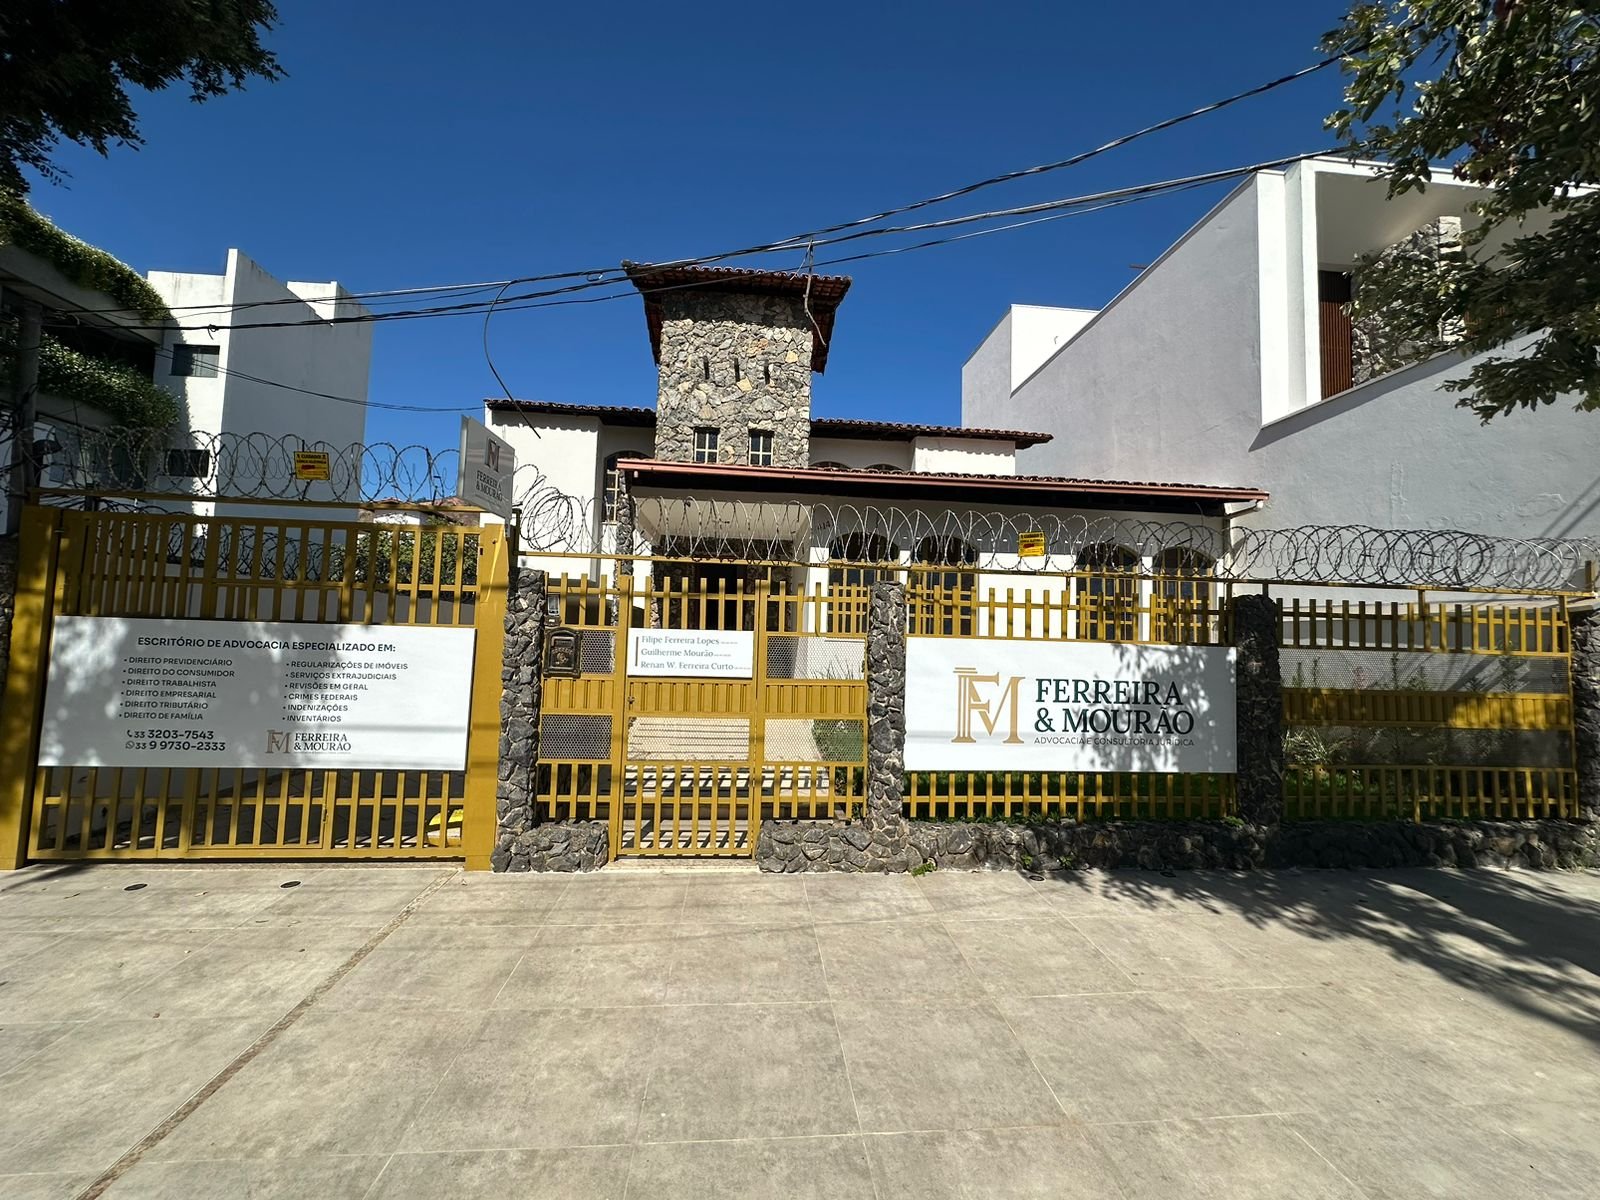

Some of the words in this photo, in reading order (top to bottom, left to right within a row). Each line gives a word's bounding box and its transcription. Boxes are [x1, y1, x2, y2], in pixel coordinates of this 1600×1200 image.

[138, 636, 205, 648] ESCRITÓRIO
[207, 640, 221, 648] DE
[223, 640, 290, 650] ADVOCACIA
[292, 642, 376, 652] ESPECIALIZADO
[378, 644, 396, 652] EM:
[641, 636, 663, 645] Filipe
[664, 636, 695, 644] Ferreira
[696, 637, 720, 646] Lopes
[640, 648, 682, 656] Guilherme
[128, 656, 162, 664] DIREITO
[163, 657, 232, 666] PREVIDENCIÁRIO
[290, 660, 362, 670] REGULARIZAÇÕES
[375, 662, 408, 670] IMÓVEIS
[640, 661, 664, 669] Renan
[679, 662, 710, 670] Ferreira
[128, 668, 160, 676] DIREITO
[176, 669, 235, 677] CONSUMIDOR
[290, 672, 330, 680] SERVIÇOS
[332, 672, 397, 680] EXTRAJUDICIAIS
[162, 680, 216, 688] TRABALHISTA
[289, 682, 328, 690] REVISÕES
[342, 683, 368, 691] GERAL
[160, 690, 217, 698] EMPRESARIAL
[1035, 678, 1184, 706] FERREIRA
[160, 701, 208, 710] TRIBUTÁRIO
[288, 704, 348, 713] INDENIZAÇÕES
[170, 712, 204, 720] FAMÍLIA
[1034, 707, 1056, 732] &
[1062, 706, 1195, 735] MOURÃO
[134, 730, 146, 739] 33
[148, 730, 214, 740] 3203-7543
[295, 732, 348, 742] FERREIRA
[1034, 736, 1086, 745] ADVOCACIA
[1094, 737, 1154, 746] CONSULTORIA
[1156, 736, 1195, 746] JURÍDICA
[149, 741, 157, 750] 9
[160, 741, 226, 751] 9730-2333
[294, 742, 302, 751] &
